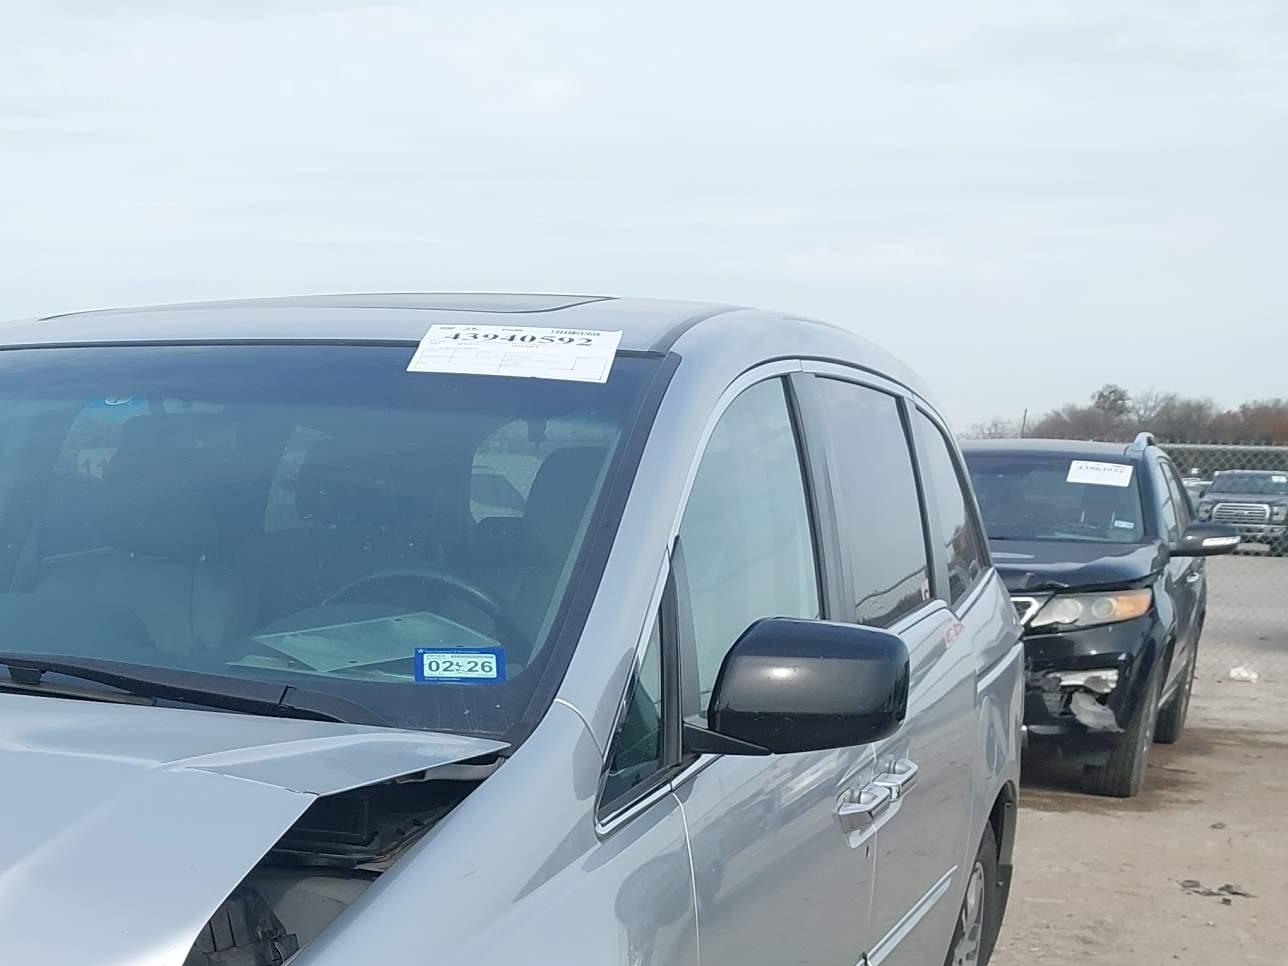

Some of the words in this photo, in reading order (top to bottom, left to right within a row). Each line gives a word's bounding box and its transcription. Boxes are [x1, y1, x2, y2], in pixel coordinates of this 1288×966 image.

[444, 332, 593, 347] 43940592
[428, 660, 454, 672] 02
[467, 660, 493, 673] 26
